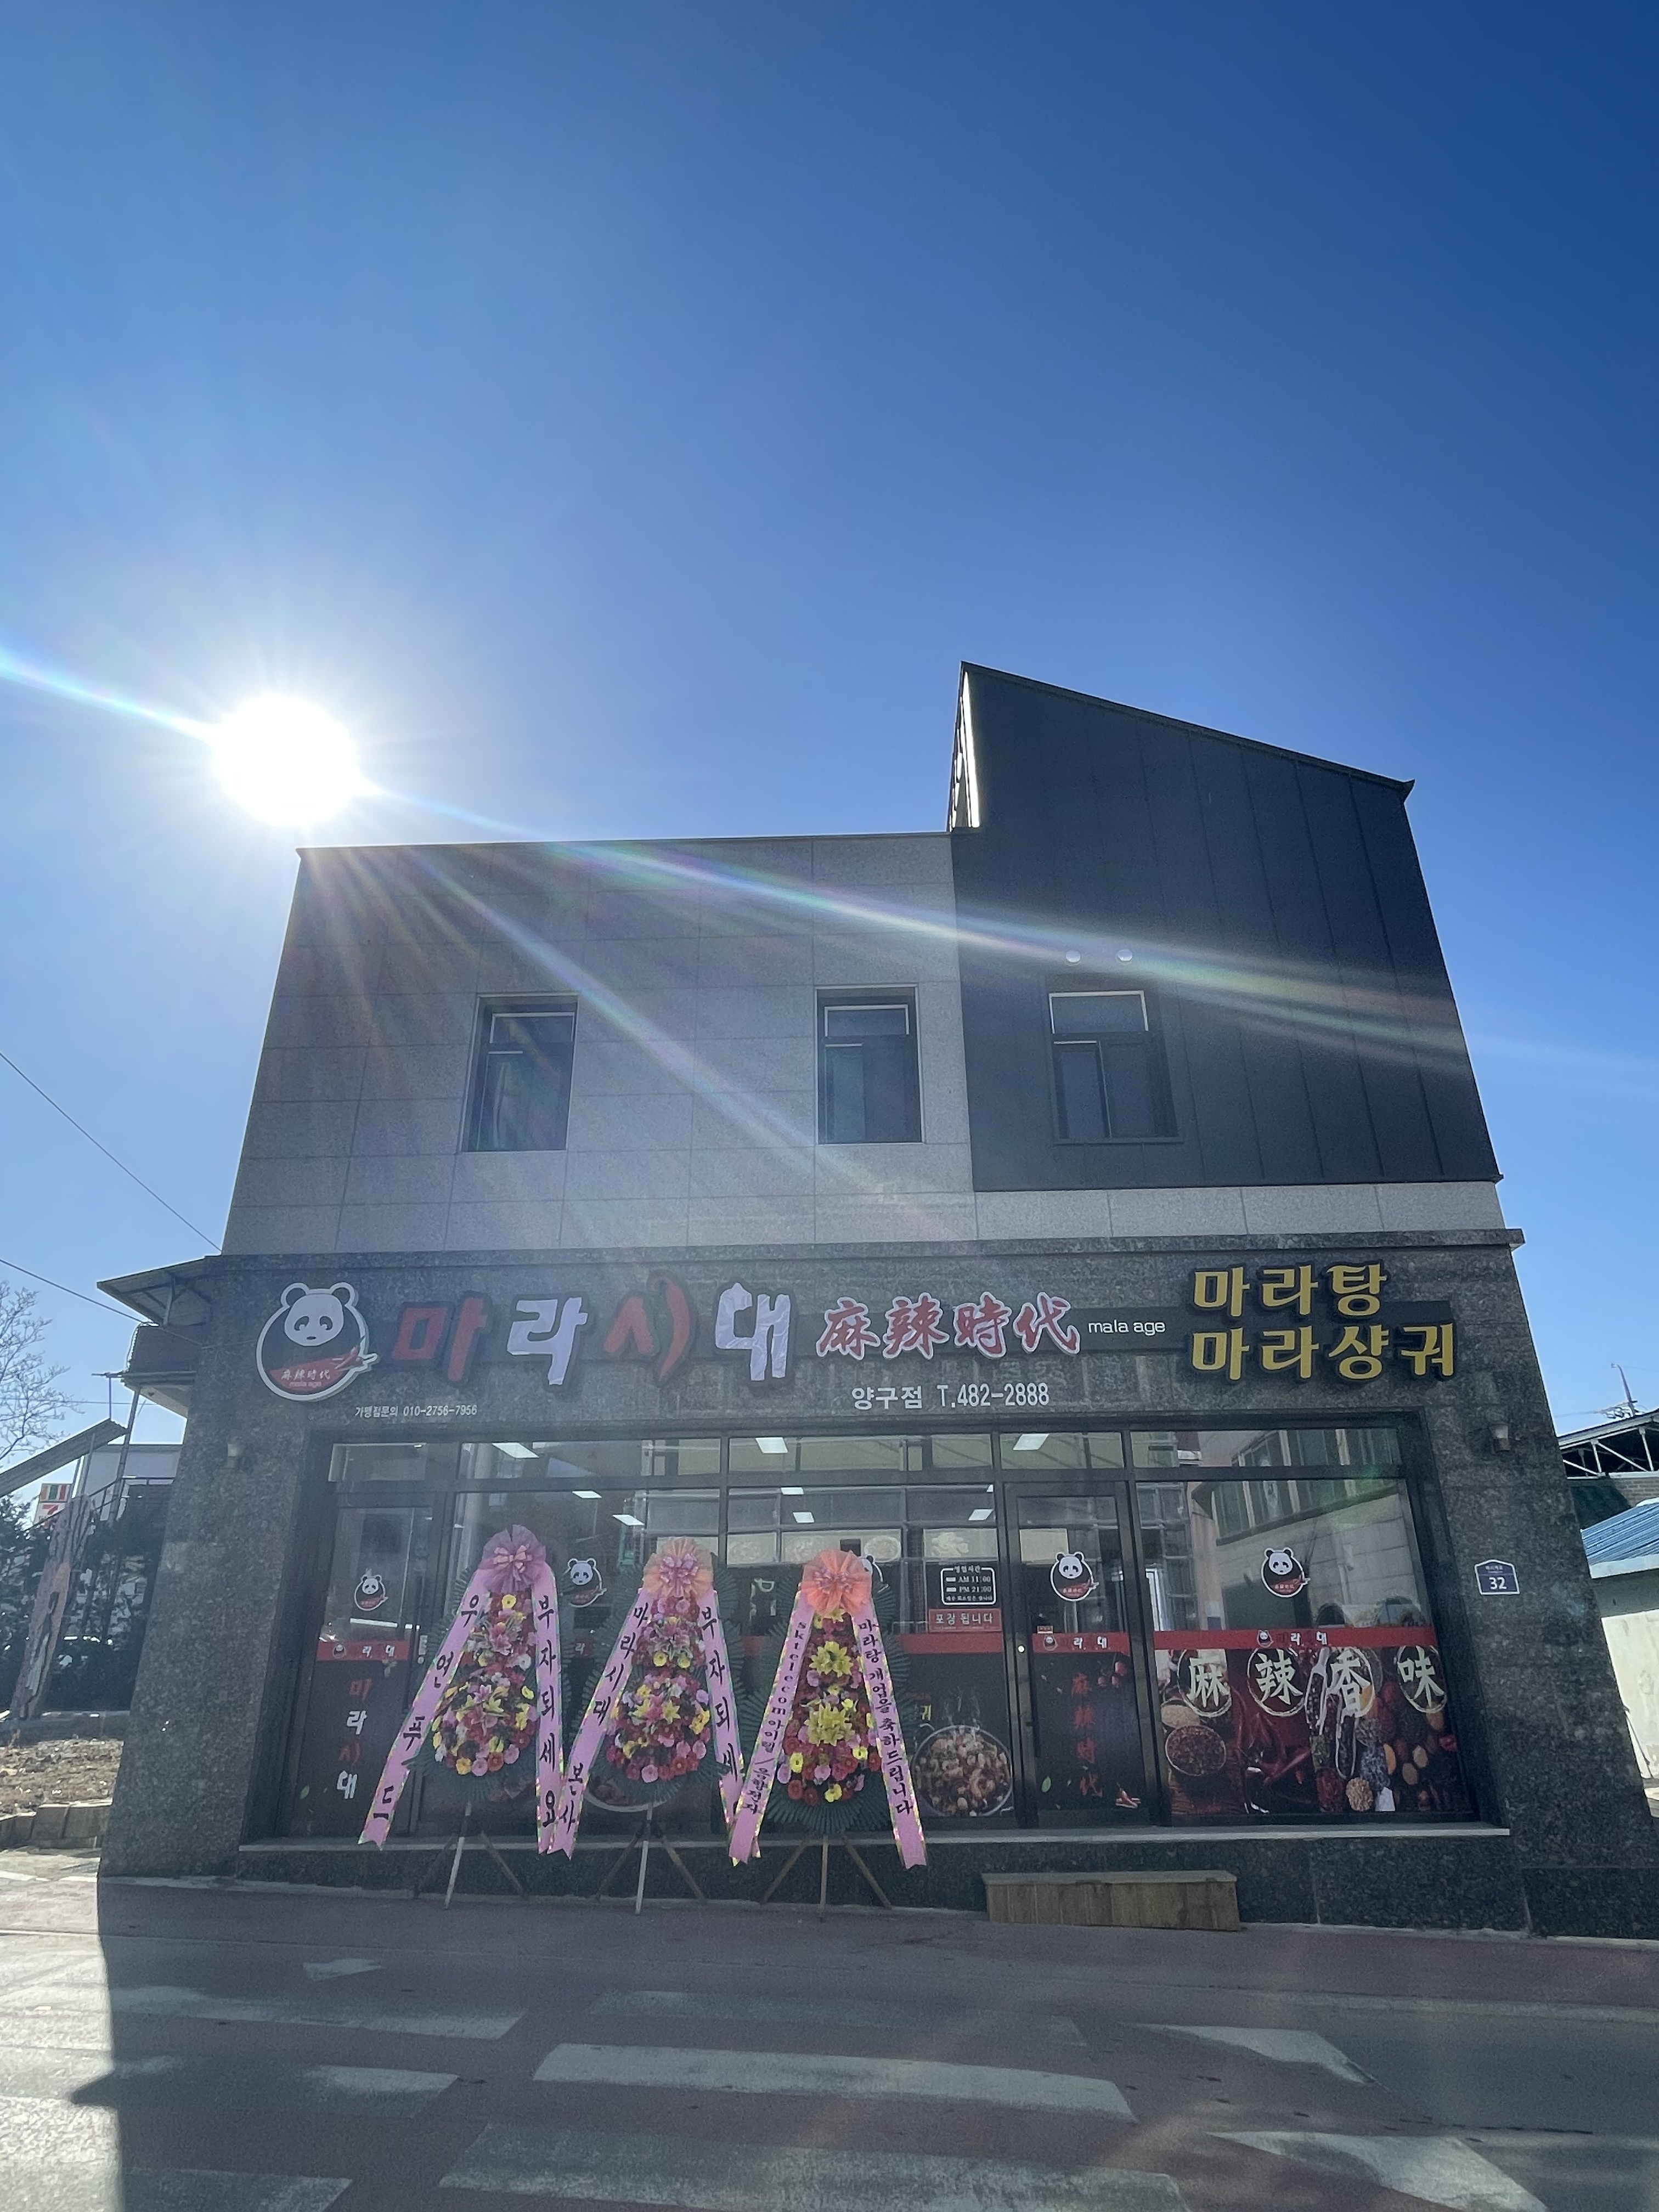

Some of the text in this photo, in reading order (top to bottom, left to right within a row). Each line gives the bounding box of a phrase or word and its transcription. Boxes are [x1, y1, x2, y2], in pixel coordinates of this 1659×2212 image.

[1192, 1263, 1387, 1318] 마라탕
[390, 1274, 791, 1385] 마라시대
[815, 1290, 1081, 1361] 麻辣時代
[1088, 1319, 1166, 1336] mala age
[1191, 1322, 1454, 1382] 마라샹궈
[354, 1405, 398, 1418] 가맹점문의
[851, 1381, 1050, 1410] 양구점 T.482-2888
[1489, 1576, 1508, 1590] 32
[960, 1612, 993, 1626] 됩니다
[537, 1594, 557, 1828] 부자되세요
[1189, 1650, 1446, 1712] 麻辣香味
[558, 1602, 648, 1835] 마라시대 본사
[857, 1618, 913, 1819] 마라탕 개업을 축하드립니다
